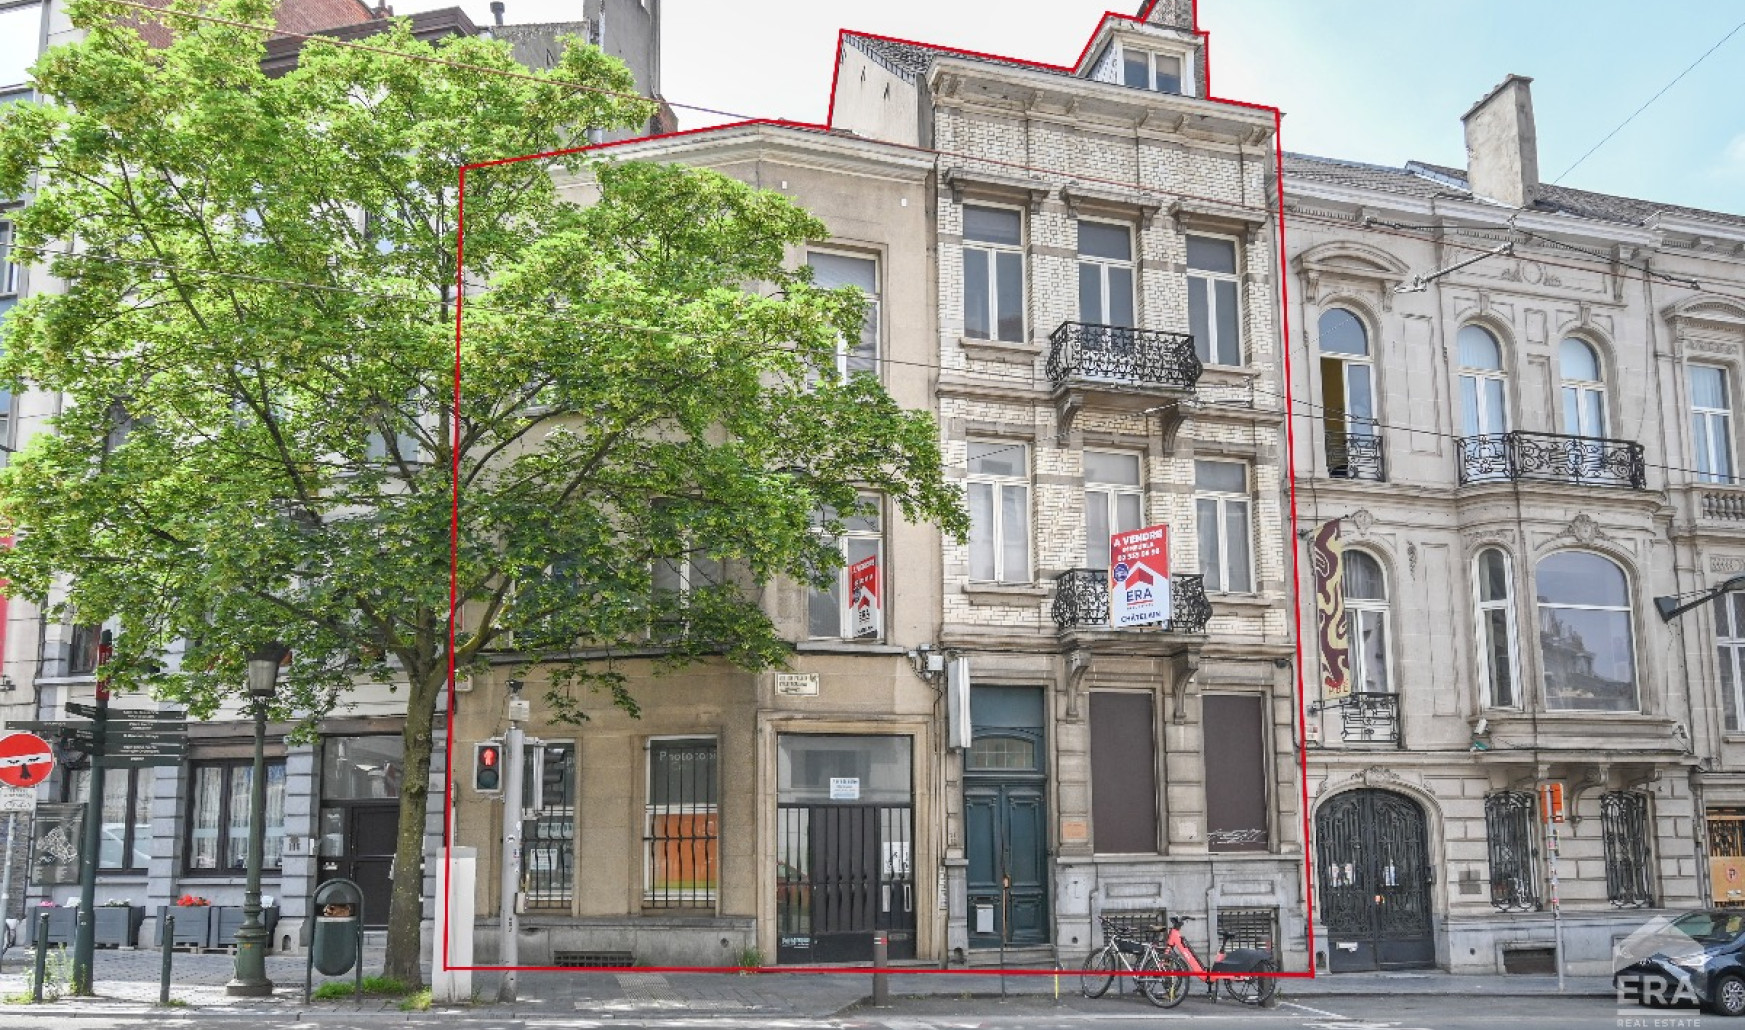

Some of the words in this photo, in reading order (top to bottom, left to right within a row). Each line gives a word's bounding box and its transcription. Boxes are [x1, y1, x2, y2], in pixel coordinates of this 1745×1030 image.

[1113, 538, 1121, 547] A
[1122, 529, 1162, 545] VENDRE
[1126, 587, 1153, 603] ERA
